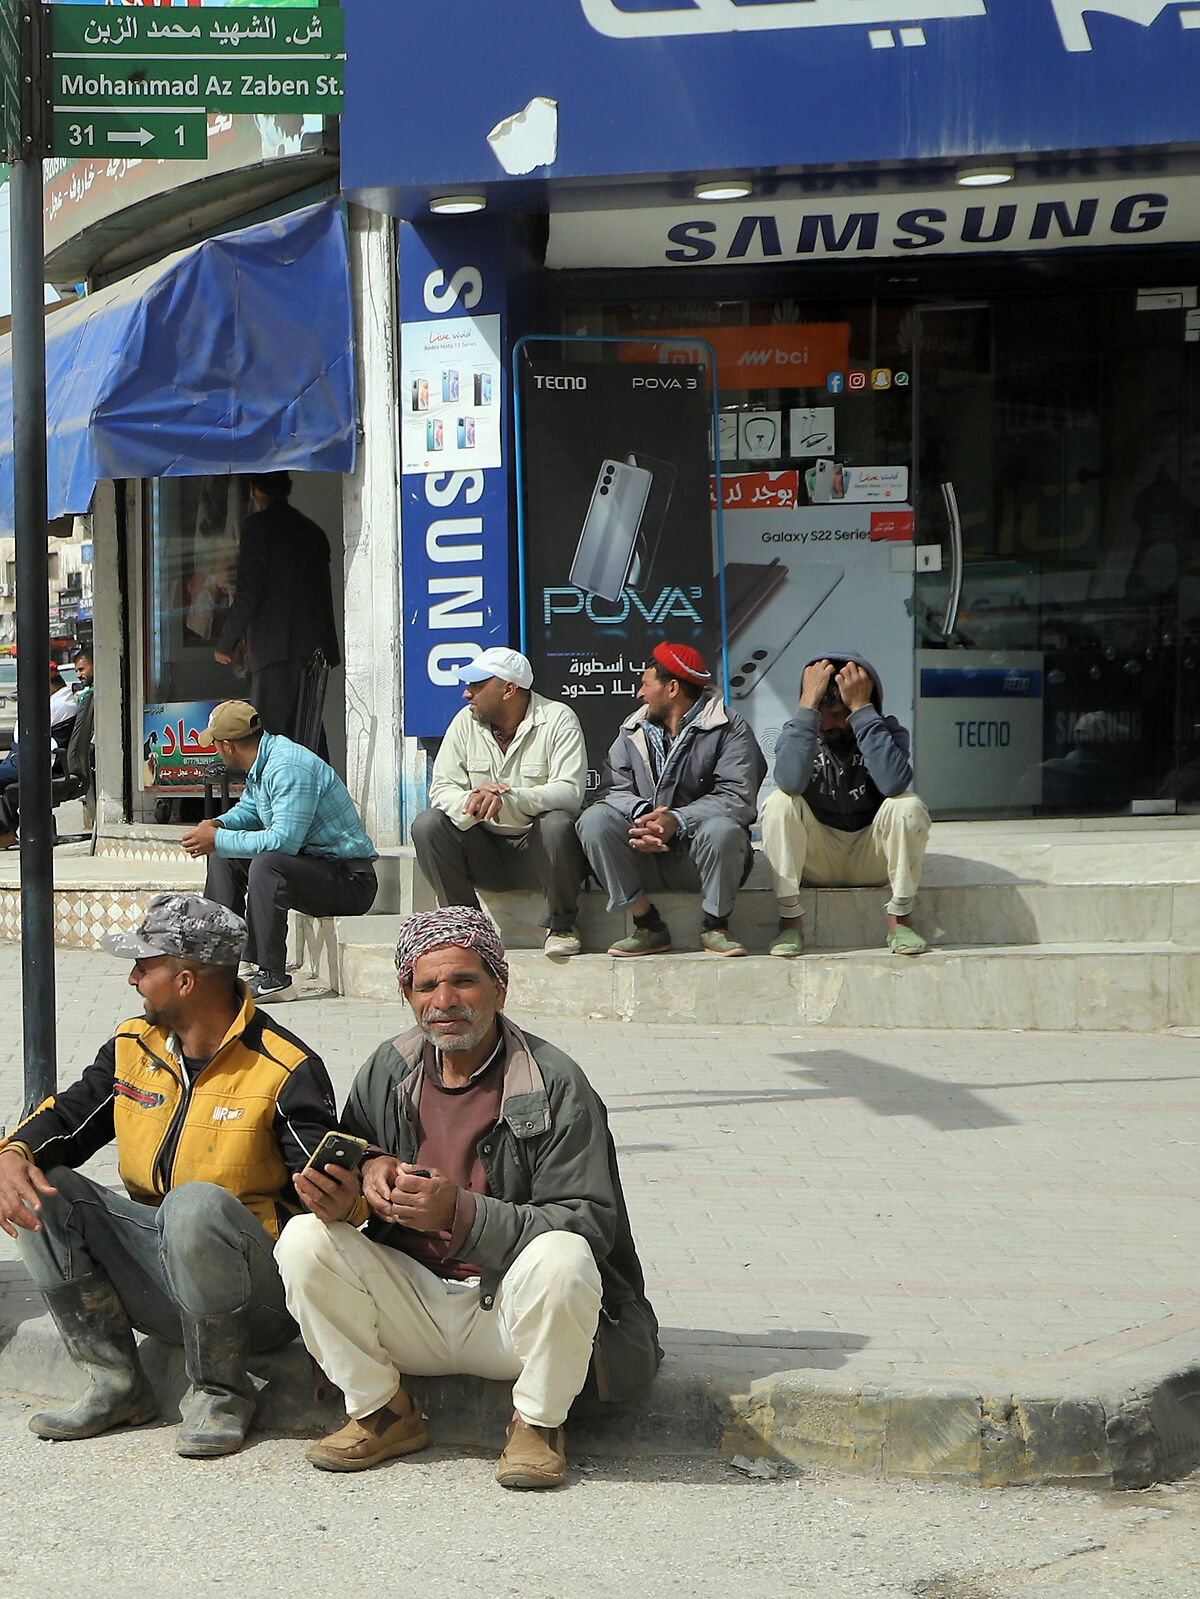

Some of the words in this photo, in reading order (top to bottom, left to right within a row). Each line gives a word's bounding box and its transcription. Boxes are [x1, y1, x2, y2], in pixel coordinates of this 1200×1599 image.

[147, 21, 201, 38] محمد
[209, 14, 277, 46] الشهيد
[61, 74, 199, 96] Mohammad
[205, 76, 233, 96] Az
[240, 75, 309, 96] Zaben
[316, 76, 345, 96] St.
[68, 125, 94, 146] 31
[174, 125, 185, 146] 1
[665, 193, 1169, 262] SAMSUNG
[429, 330, 450, 344] Live
[452, 328, 472, 339] vivid
[775, 347, 809, 365] bci
[534, 375, 587, 390] TECNO
[632, 377, 683, 390] POVA
[686, 377, 698, 389] 3
[423, 265, 485, 687] SSUNG
[751, 484, 794, 506] يوجد
[762, 531, 807, 543] Galaxy
[811, 529, 831, 541] S22
[569, 654, 623, 676] أسطورة
[561, 683, 604, 698] حدود
[955, 721, 1011, 748] TECNO
